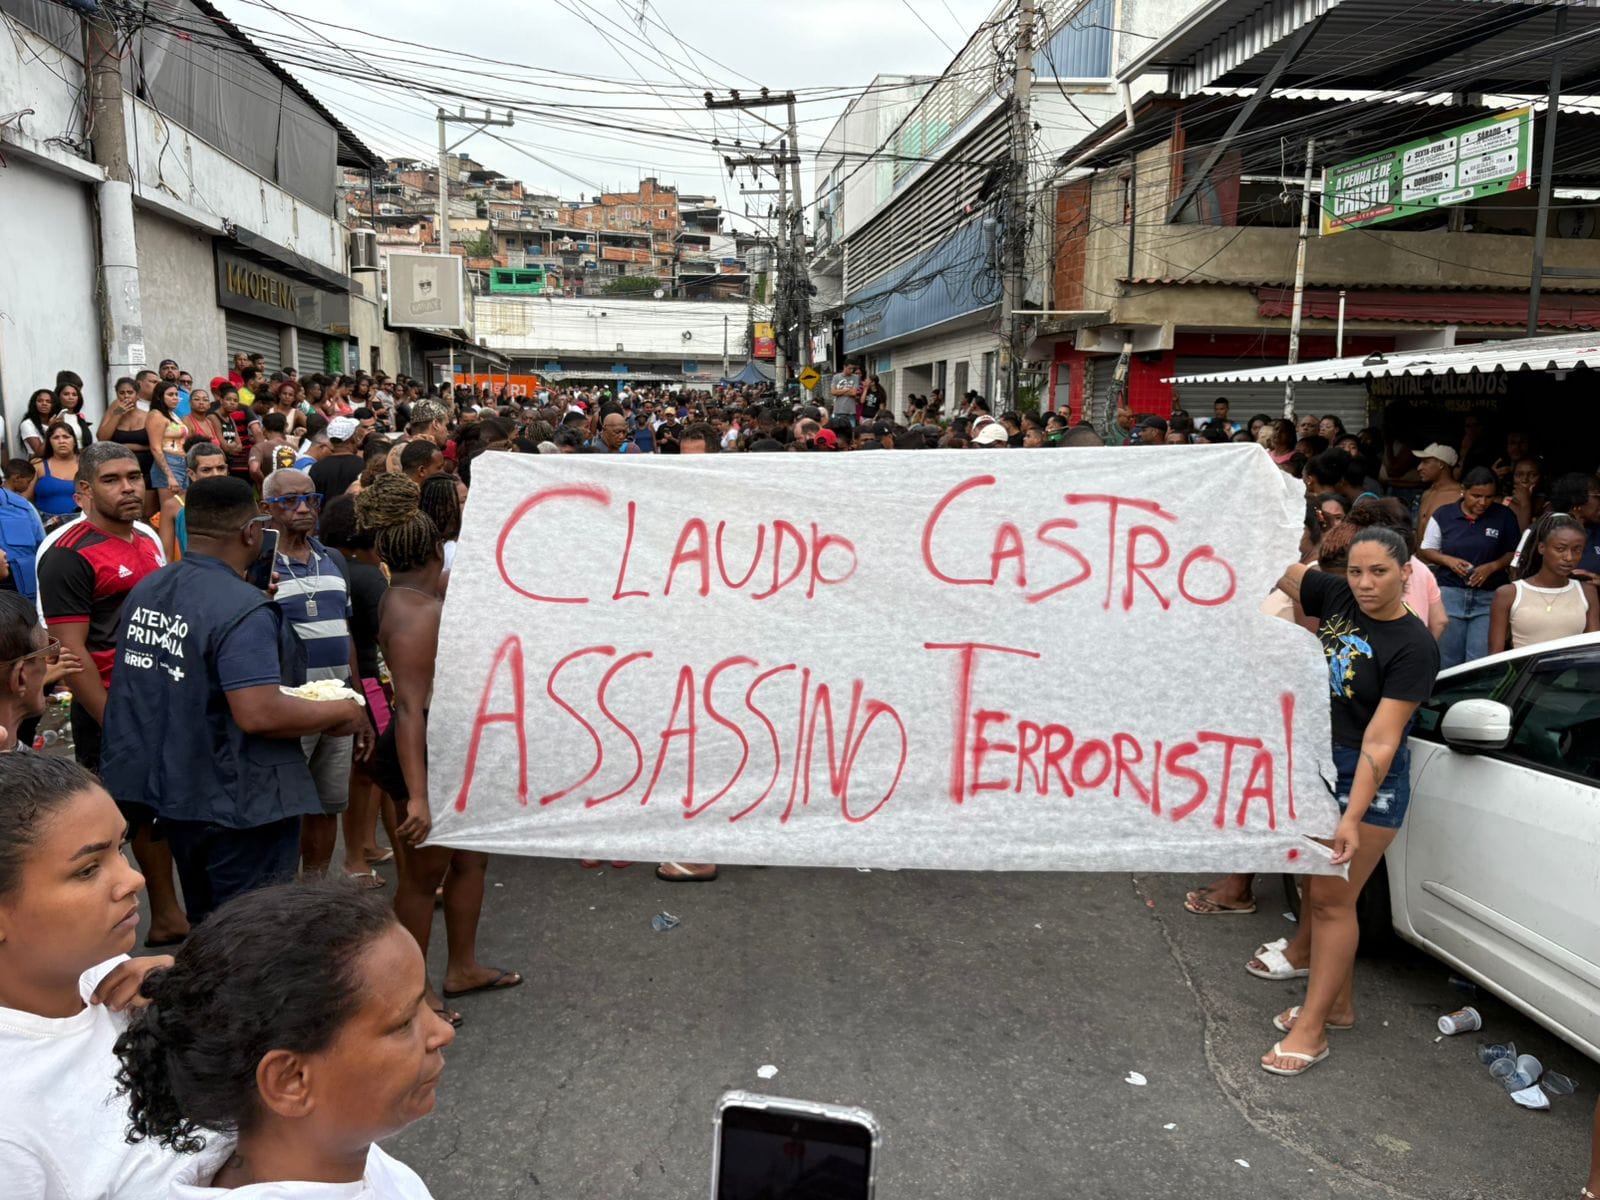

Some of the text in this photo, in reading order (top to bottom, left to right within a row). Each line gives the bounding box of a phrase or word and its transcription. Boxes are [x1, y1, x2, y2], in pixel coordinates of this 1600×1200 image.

[1335, 177, 1342, 192] A
[1343, 168, 1372, 189] PENHA
[1372, 164, 1380, 181] É
[1379, 162, 1393, 178] DE
[1413, 171, 1444, 187] DOMINGO
[1333, 179, 1390, 217] CRISTO
[496, 474, 1238, 612] CLAUDIO CASTRO
[131, 606, 189, 639] ATENÃO
[130, 654, 154, 669] RIO
[454, 634, 908, 823] ASSASSINO
